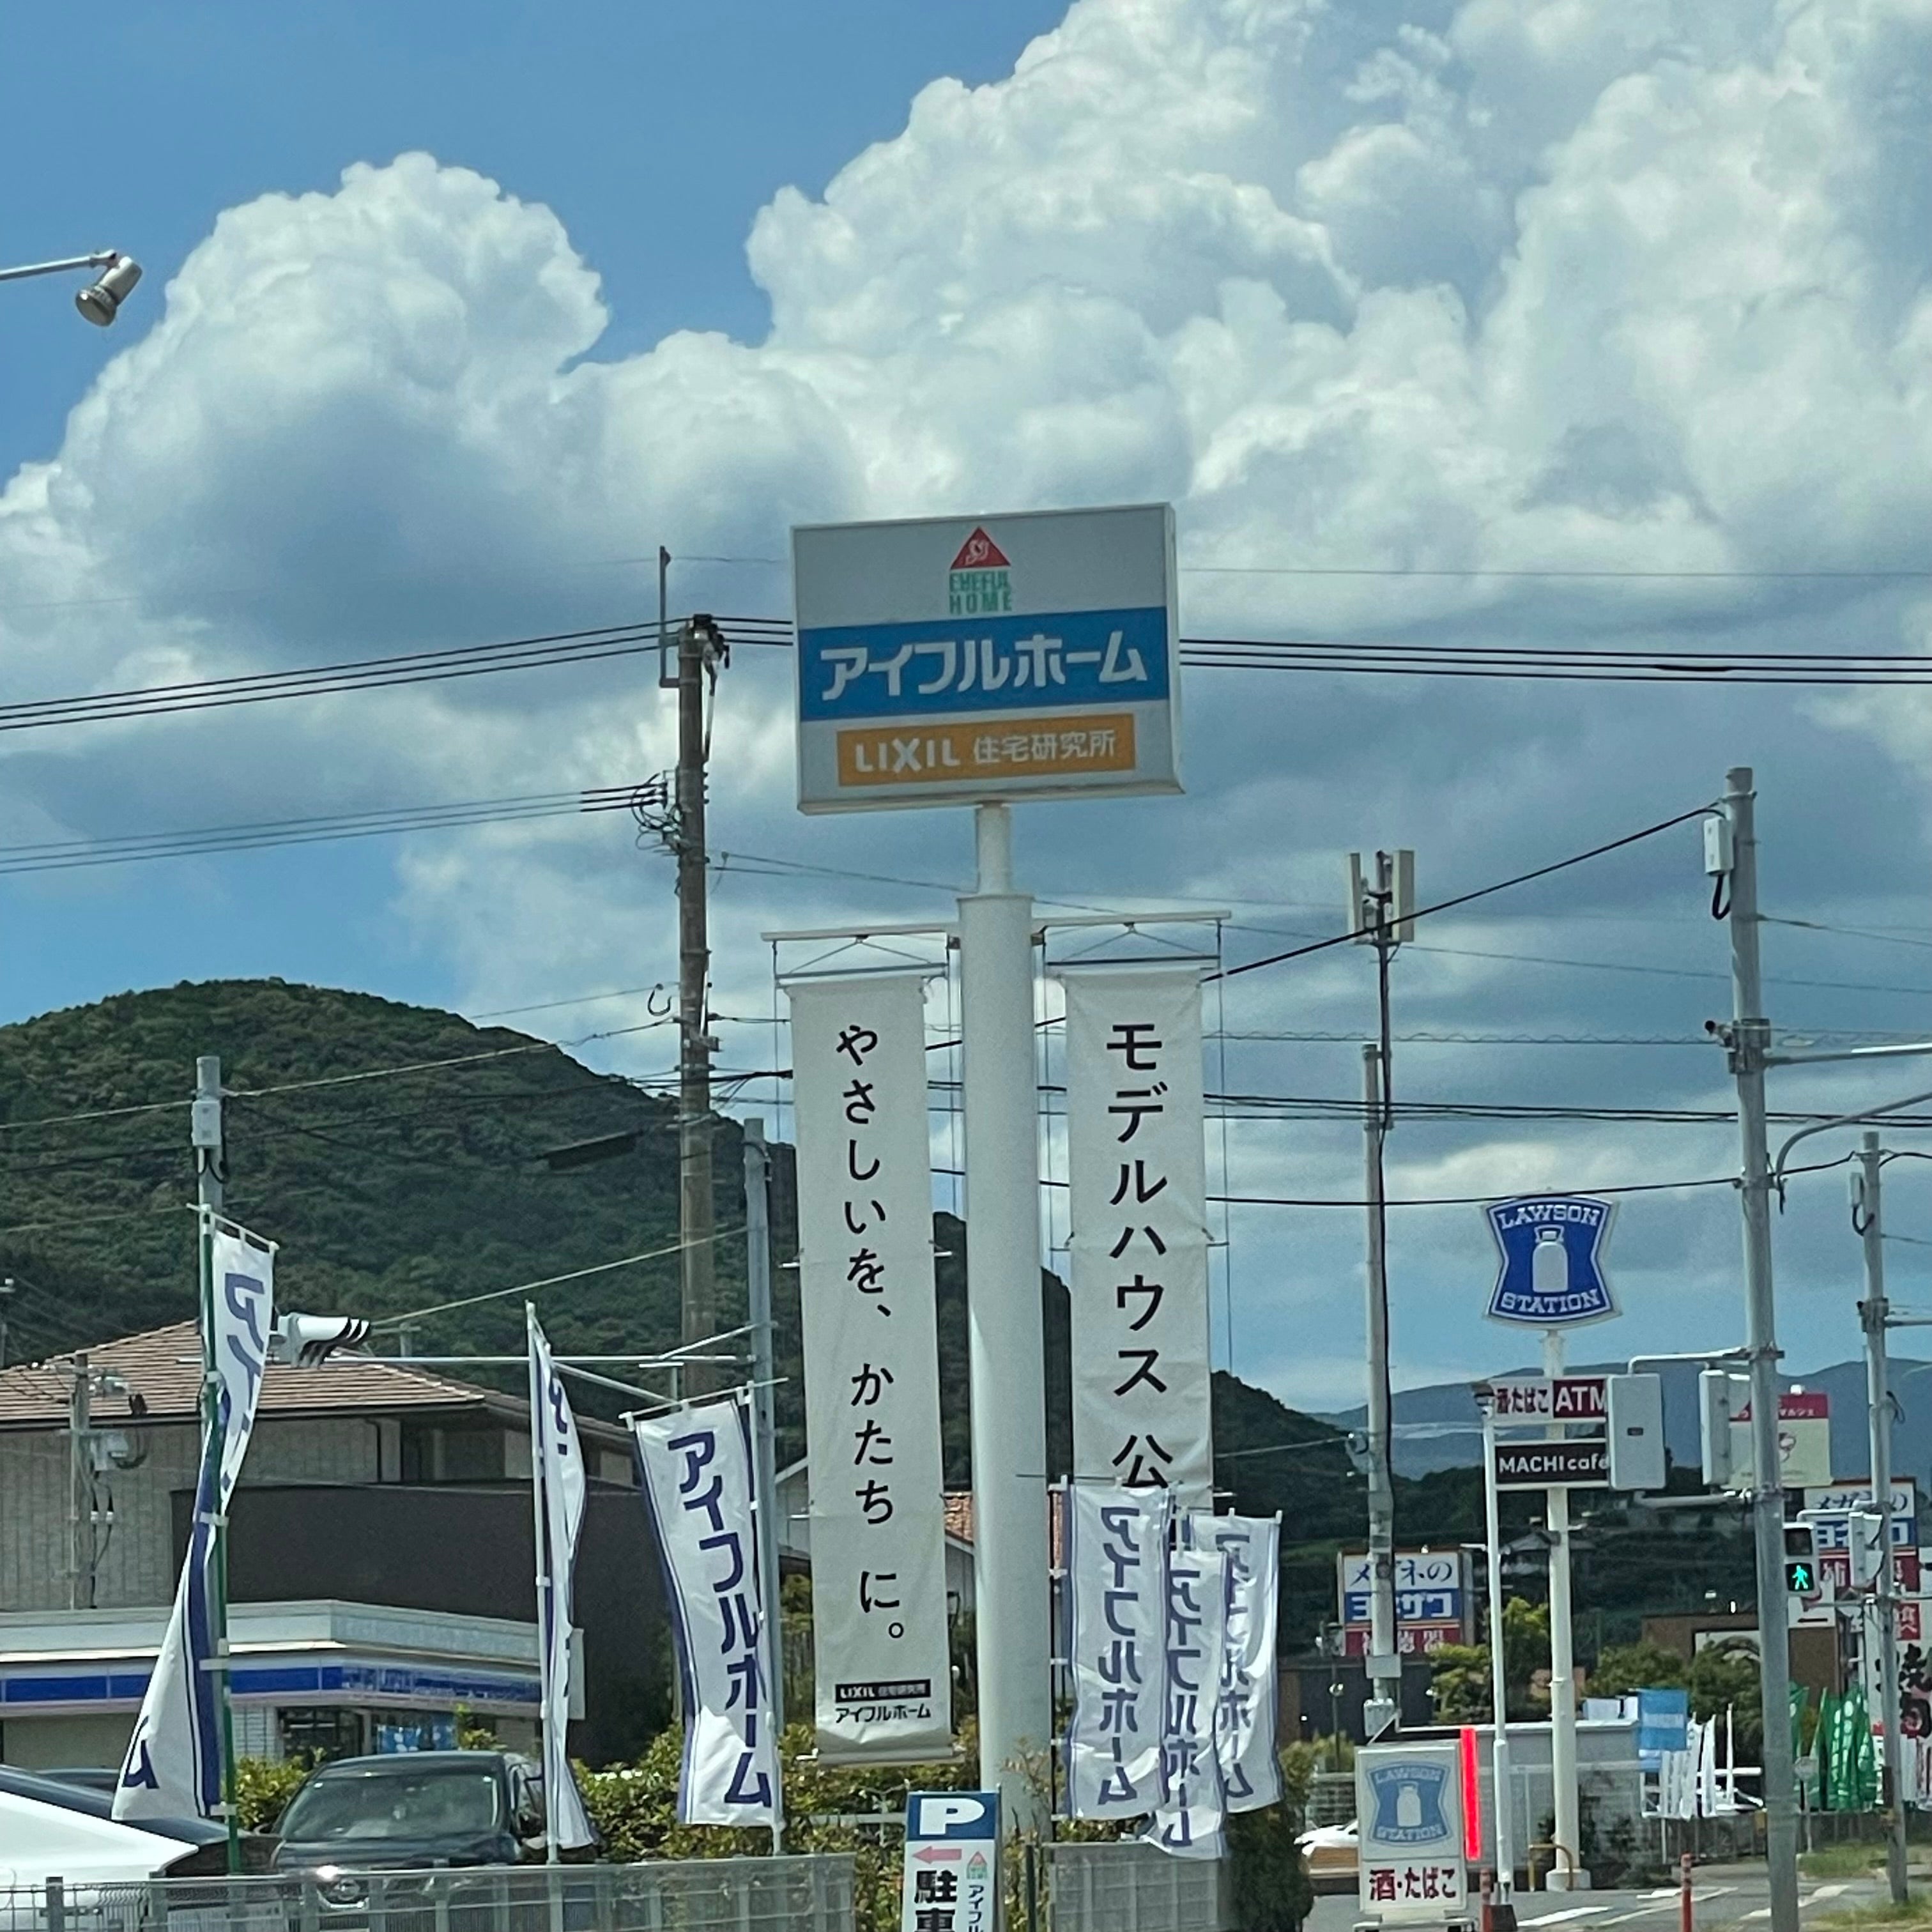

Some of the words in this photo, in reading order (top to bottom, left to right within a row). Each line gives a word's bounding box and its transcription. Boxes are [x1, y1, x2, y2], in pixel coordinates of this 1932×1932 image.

[949, 591, 1013, 615] HOME
[820, 630, 1147, 701] アイフルホーム
[855, 737, 961, 774] LIXIL
[973, 729, 1116, 764] 住宅研究所
[1497, 1204, 1600, 1230] LAWSON
[1500, 1288, 1600, 1315] STATION
[1555, 1386, 1606, 1412] ATM
[1498, 1454, 1565, 1474] MACHI
[1350, 1559, 1453, 1587] メネの
[668, 1430, 772, 1809] アイフルホーム
[839, 1686, 876, 1699] LIXIL
[835, 1703, 931, 1724] アイフルホーム
[1374, 1767, 1443, 1785] LAWSON
[920, 1798, 985, 1836] P
[1376, 1823, 1445, 1841] STATION
[1369, 1866, 1457, 1901] 酒・たばこ
